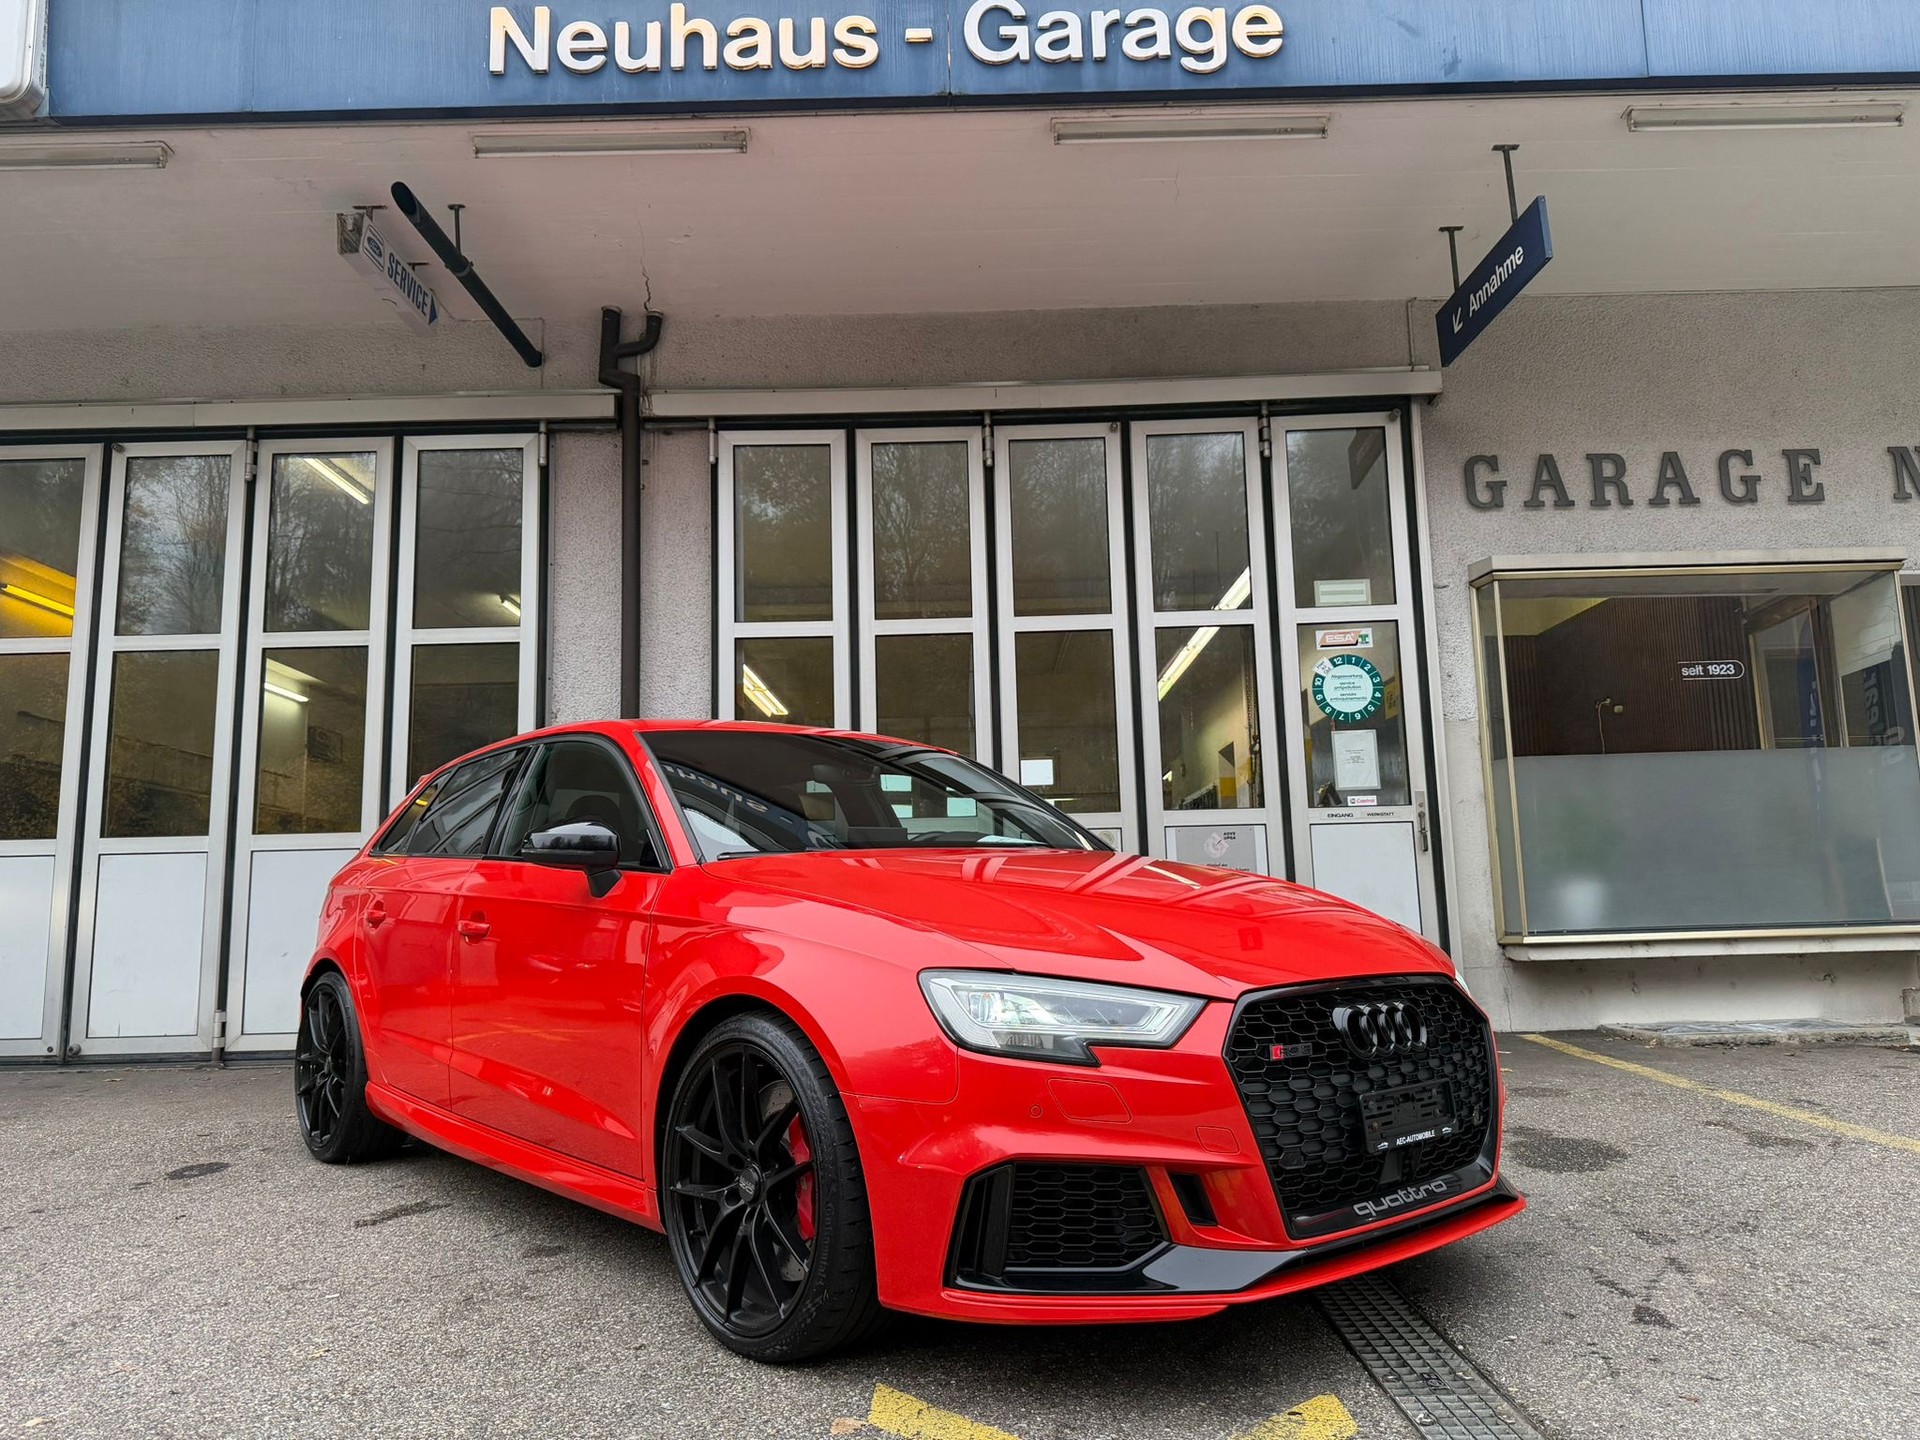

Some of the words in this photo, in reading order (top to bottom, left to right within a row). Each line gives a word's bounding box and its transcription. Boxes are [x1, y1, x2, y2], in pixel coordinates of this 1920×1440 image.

[488, 3, 880, 76] Neuhaus
[963, 0, 1285, 74] Garage
[388, 252, 429, 316] SERVICE
[1469, 245, 1524, 317] Annahme
[1463, 448, 1826, 509] GARAGE
[1326, 633, 1353, 643] ESA
[1333, 656, 1343, 665] 12
[1351, 656, 1356, 664] 1
[1681, 664, 1704, 676] seit
[1706, 664, 1736, 675] 1923
[1314, 677, 1323, 686] 10
[1324, 706, 1332, 714] 8
[1367, 704, 1375, 712] 5
[1338, 713, 1345, 721] 7
[1354, 712, 1361, 720] 6
[1396, 1129, 1435, 1146] AEC-AUTOMOBILE
[1353, 1180, 1448, 1216] quattro
